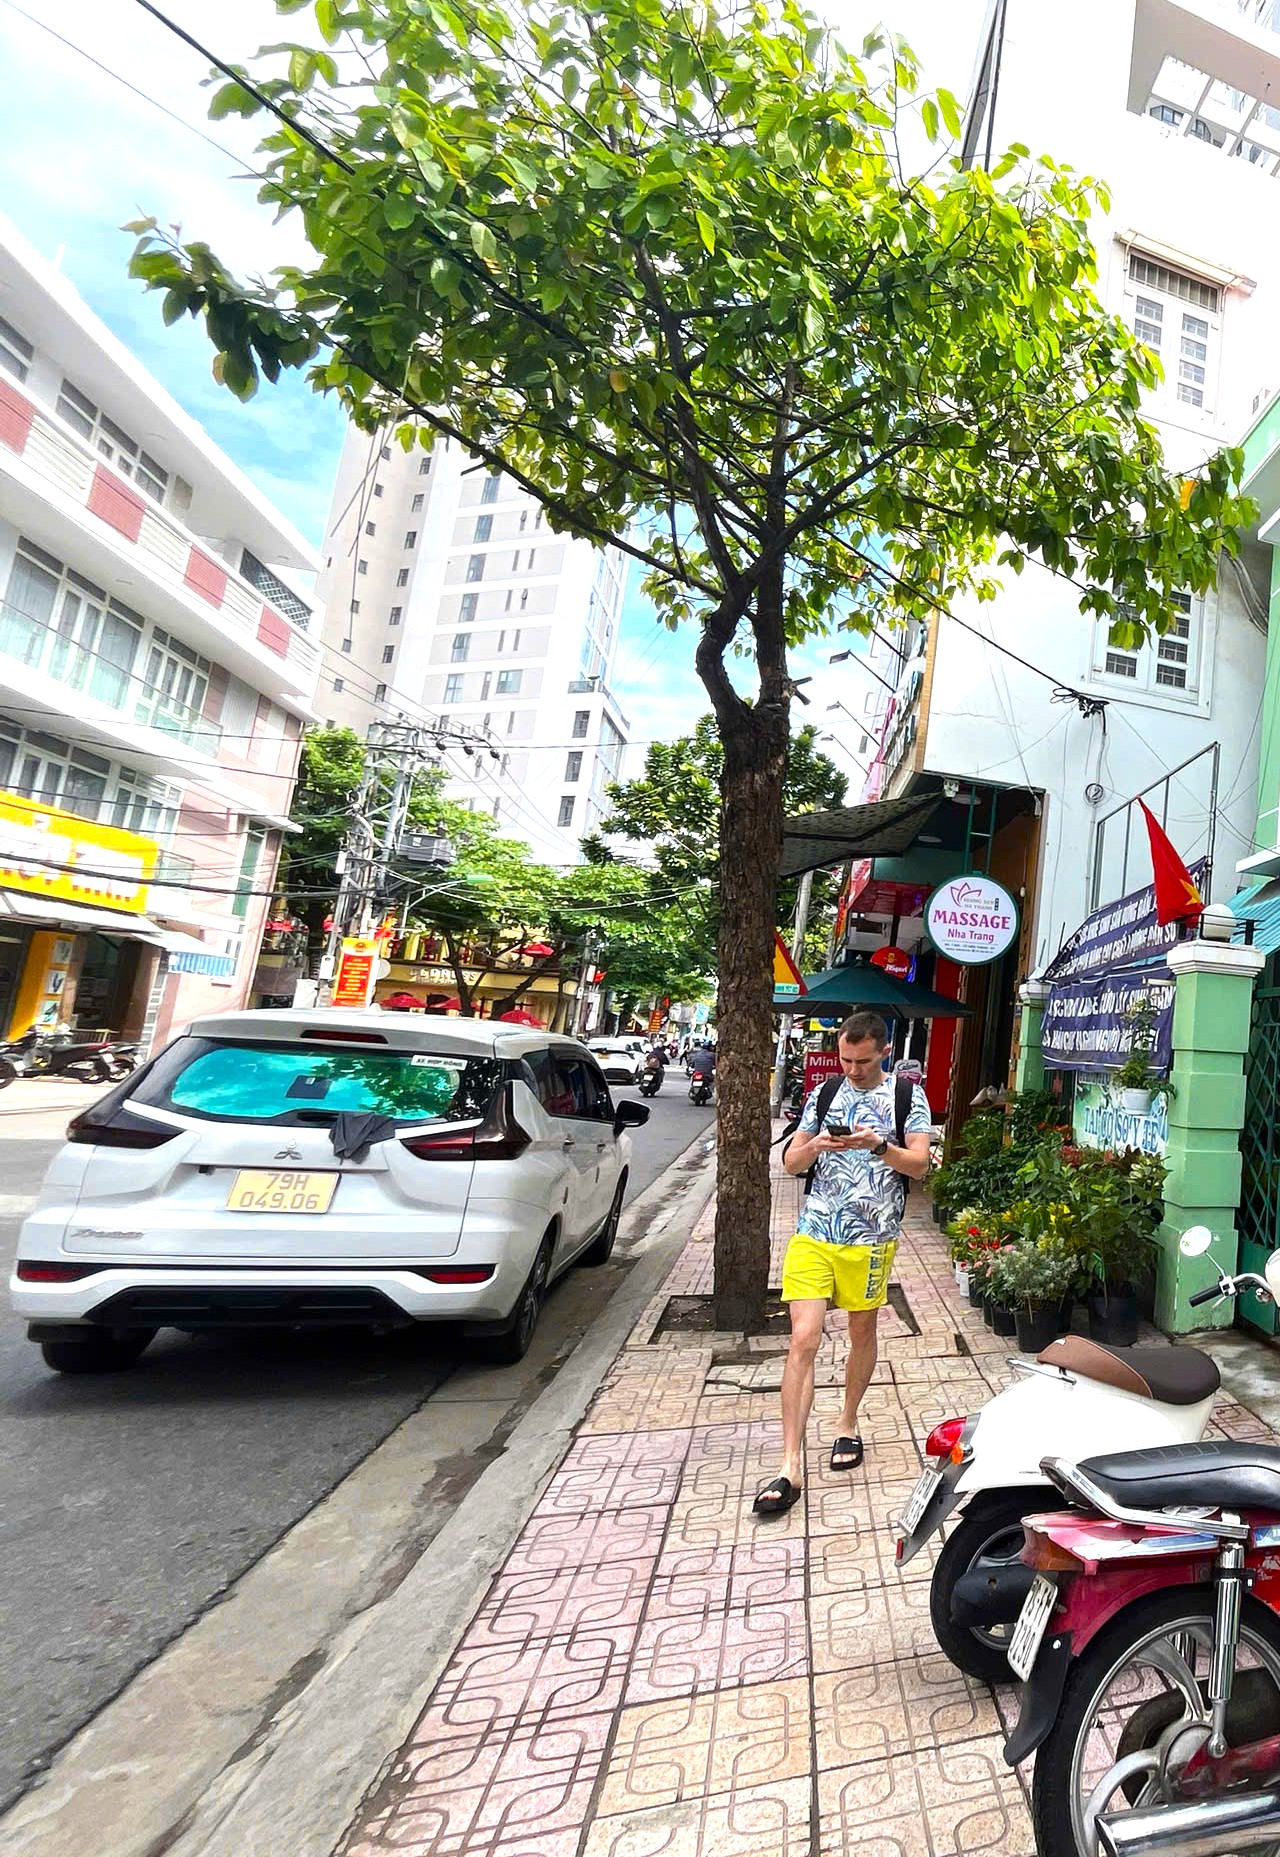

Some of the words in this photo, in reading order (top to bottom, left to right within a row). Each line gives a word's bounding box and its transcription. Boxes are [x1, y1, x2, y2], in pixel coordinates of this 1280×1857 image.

[932, 909, 1011, 930] MASSAGE
[947, 928, 966, 939] Nha
[969, 930, 994, 944] Trang
[809, 1056, 838, 1067] Mini
[265, 1172, 310, 1190] 79H
[239, 1190, 320, 1210] 049.06
